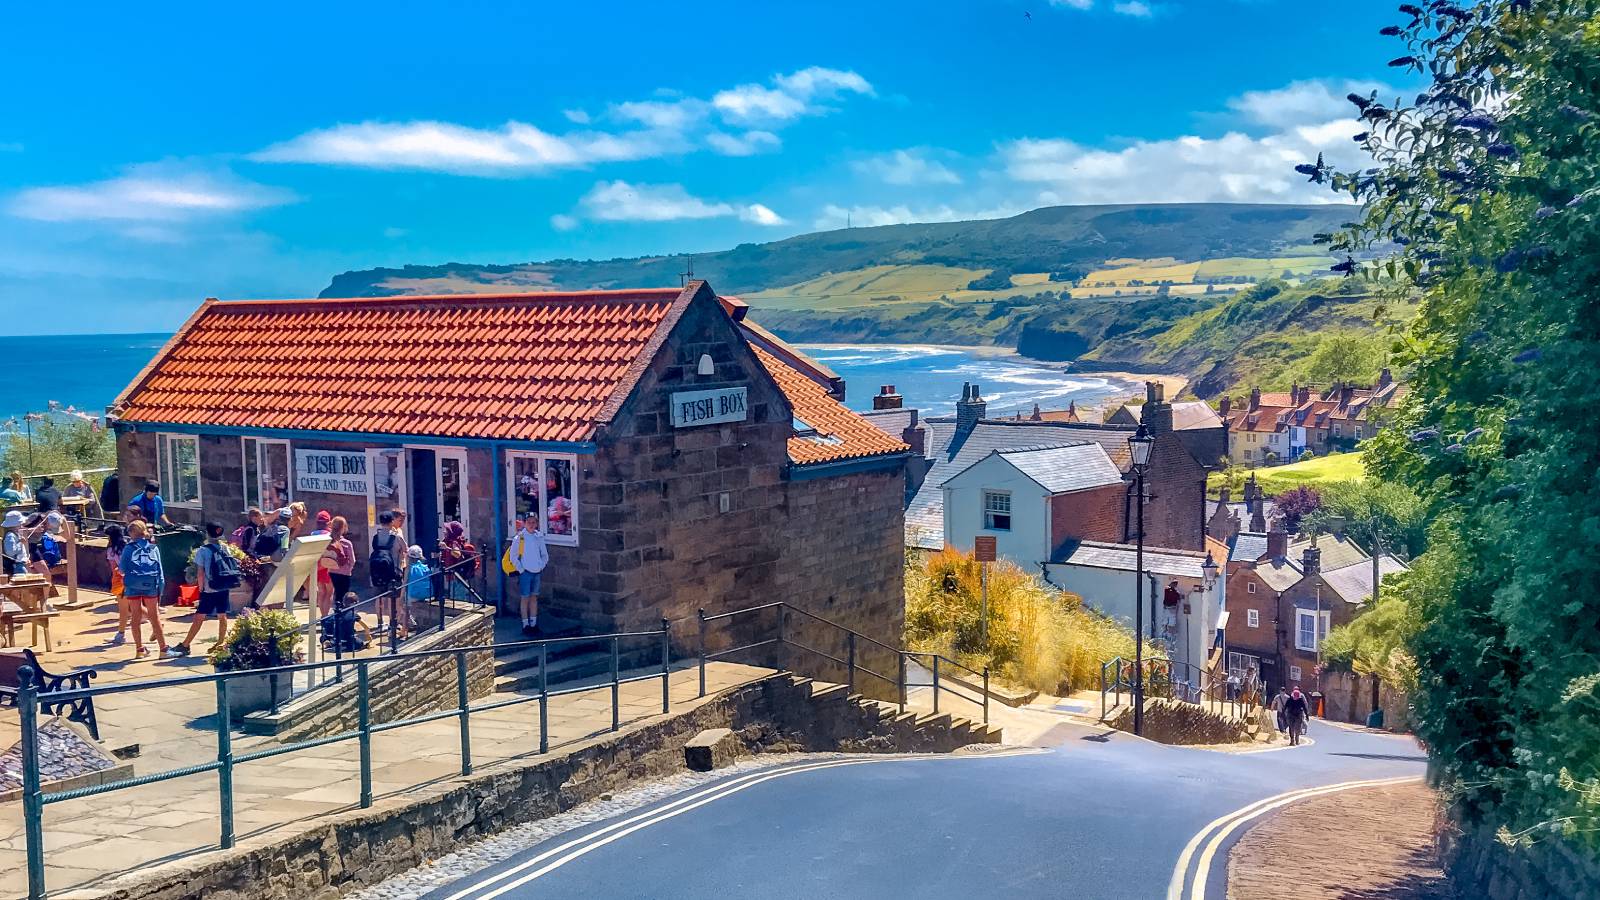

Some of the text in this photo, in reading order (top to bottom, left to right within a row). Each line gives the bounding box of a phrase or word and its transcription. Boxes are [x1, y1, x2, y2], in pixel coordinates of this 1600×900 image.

[681, 392, 744, 423] FISH BOX
[306, 455, 366, 475] FISH BOX
[300, 477, 320, 490] CAFE
[323, 479, 338, 491] AND
